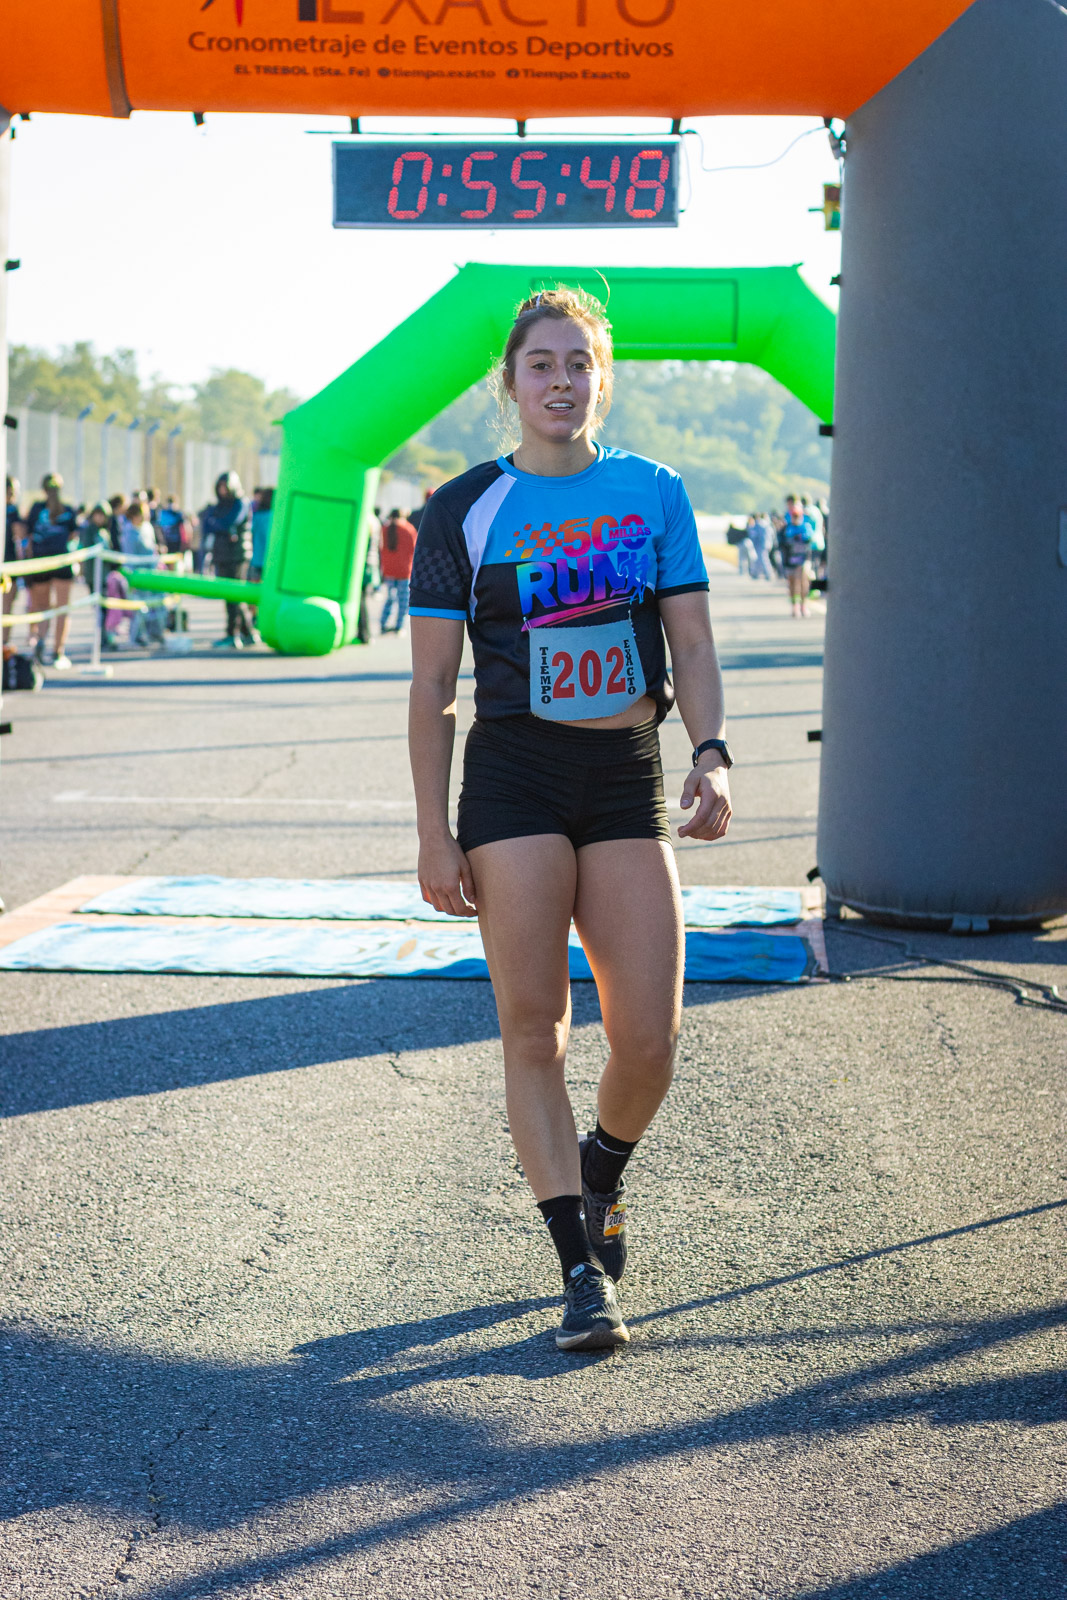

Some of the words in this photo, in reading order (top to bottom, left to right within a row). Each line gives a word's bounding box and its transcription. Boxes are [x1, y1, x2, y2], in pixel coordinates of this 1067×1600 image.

[188, 31, 367, 57] Cronometraje
[373, 35, 406, 54] de
[414, 35, 518, 56] Eventos
[526, 36, 674, 60] Deportivos
[234, 64, 250, 75] EL
[523, 68, 578, 81] Tiempo
[581, 69, 631, 80] Exacto
[387, 149, 670, 220] 0:55:48
[559, 514, 648, 558] 500
[609, 527, 651, 539] MILLAS
[539, 646, 552, 705] TIEMPO
[551, 646, 626, 699] 202
[623, 639, 636, 695] EXACTO
[609, 1213, 623, 1225] 202
